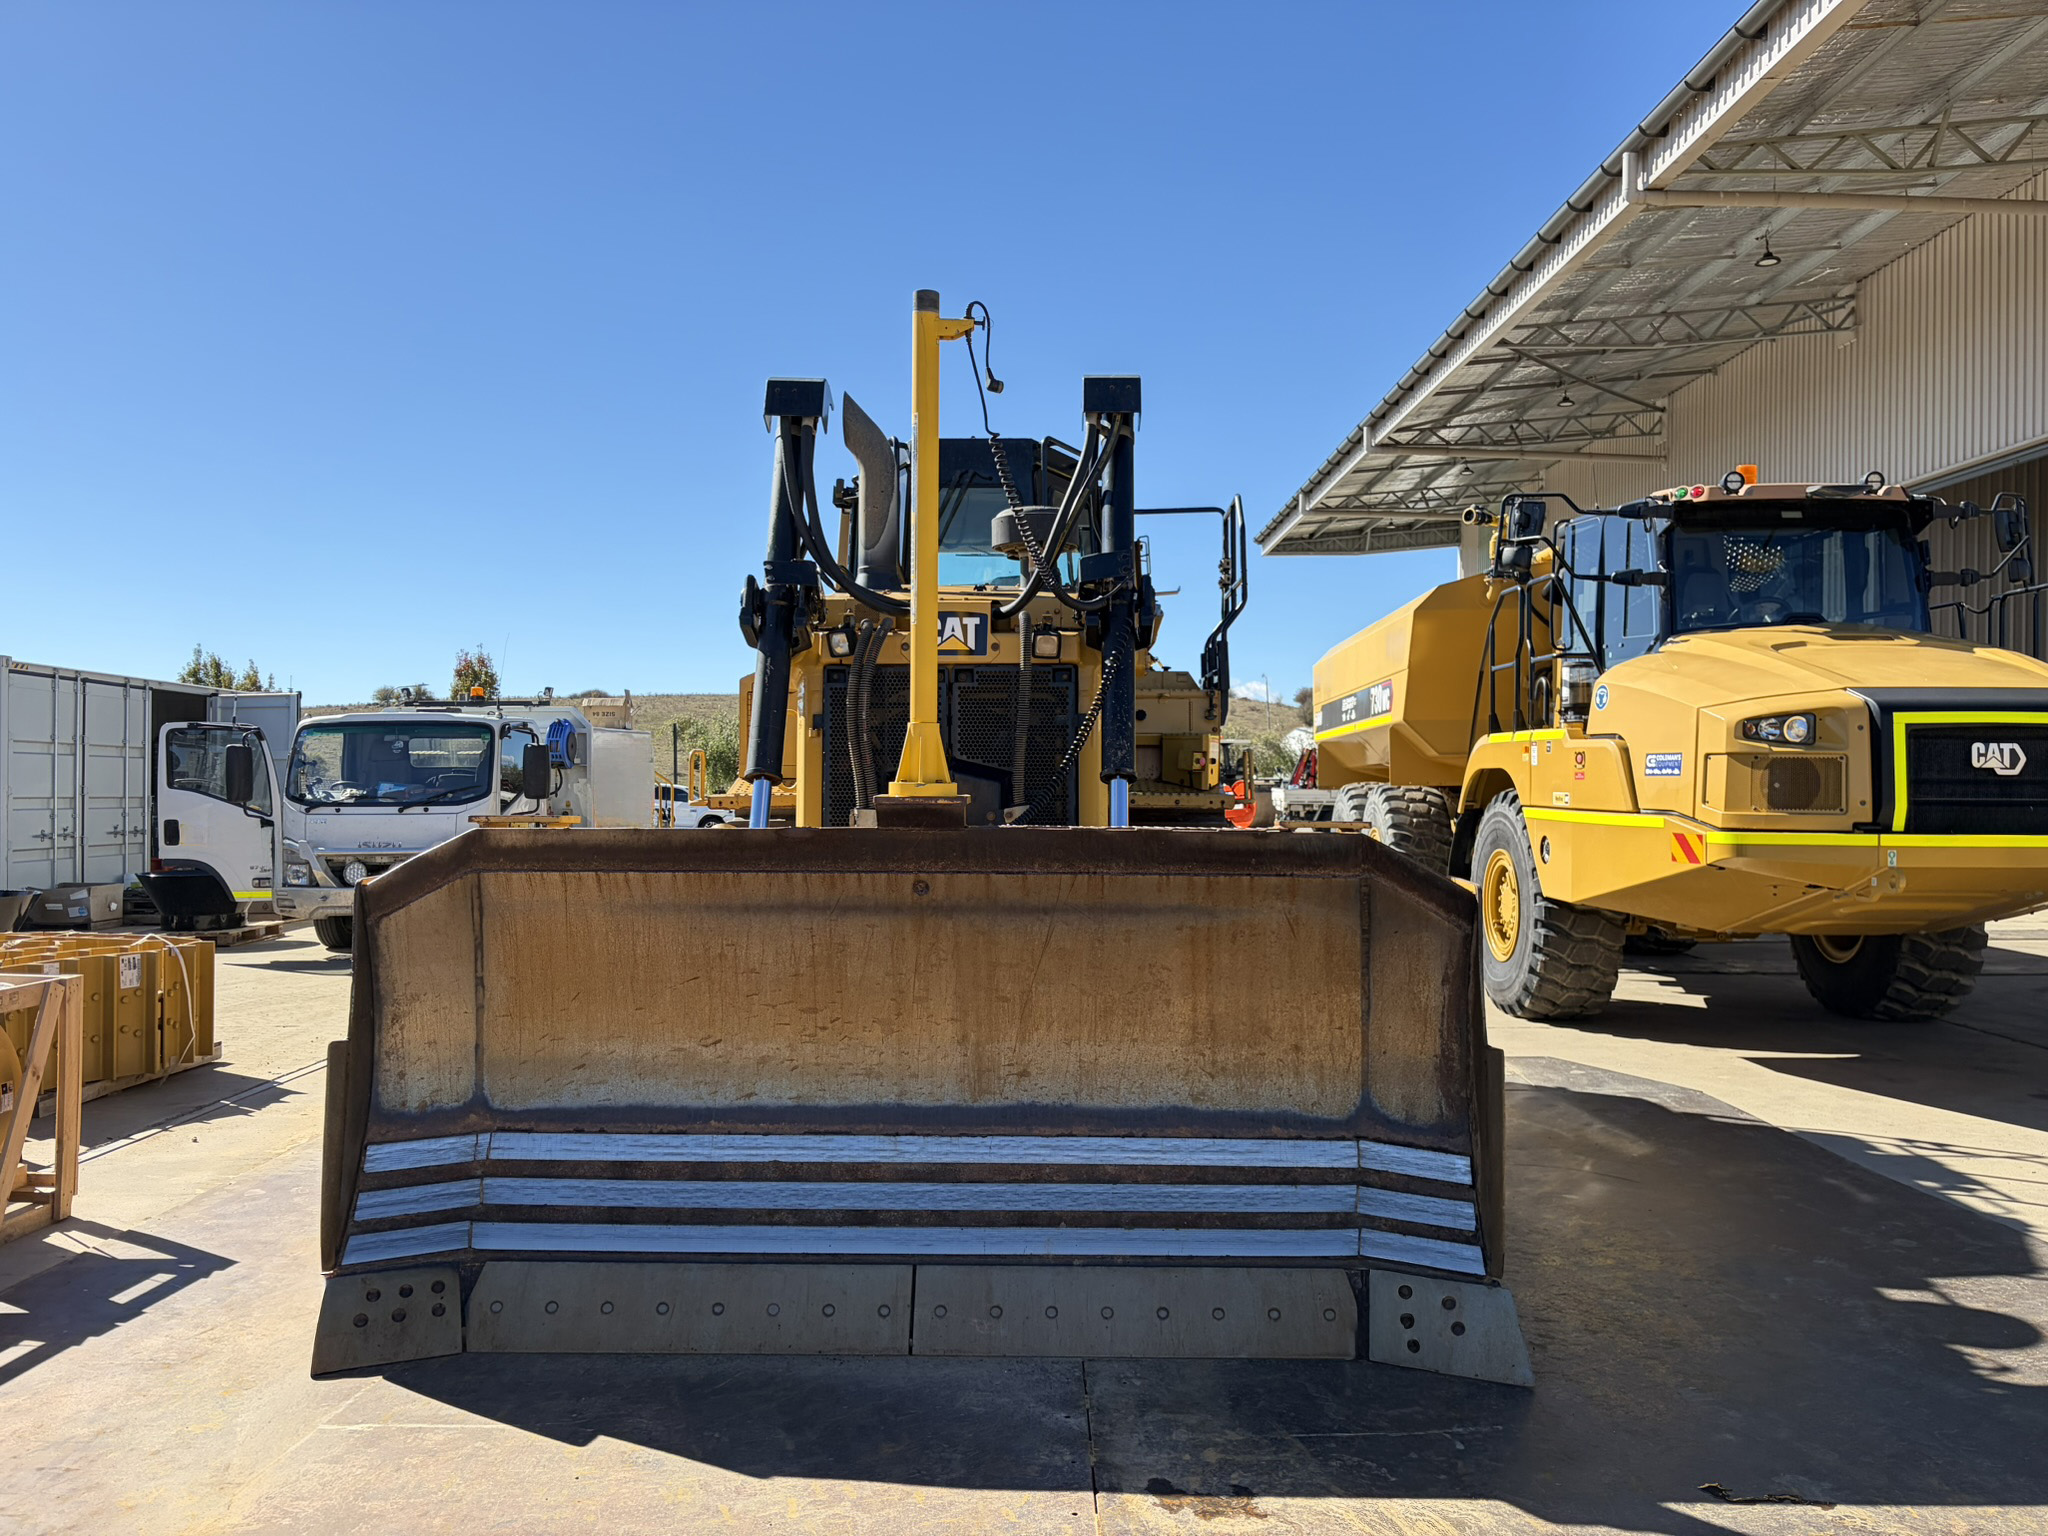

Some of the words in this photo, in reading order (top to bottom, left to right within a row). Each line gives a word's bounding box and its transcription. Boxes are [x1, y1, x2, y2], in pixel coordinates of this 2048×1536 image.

[938, 617, 980, 650] AT
[1971, 742, 2012, 769] CAT
[357, 840, 402, 849] ISUZU
